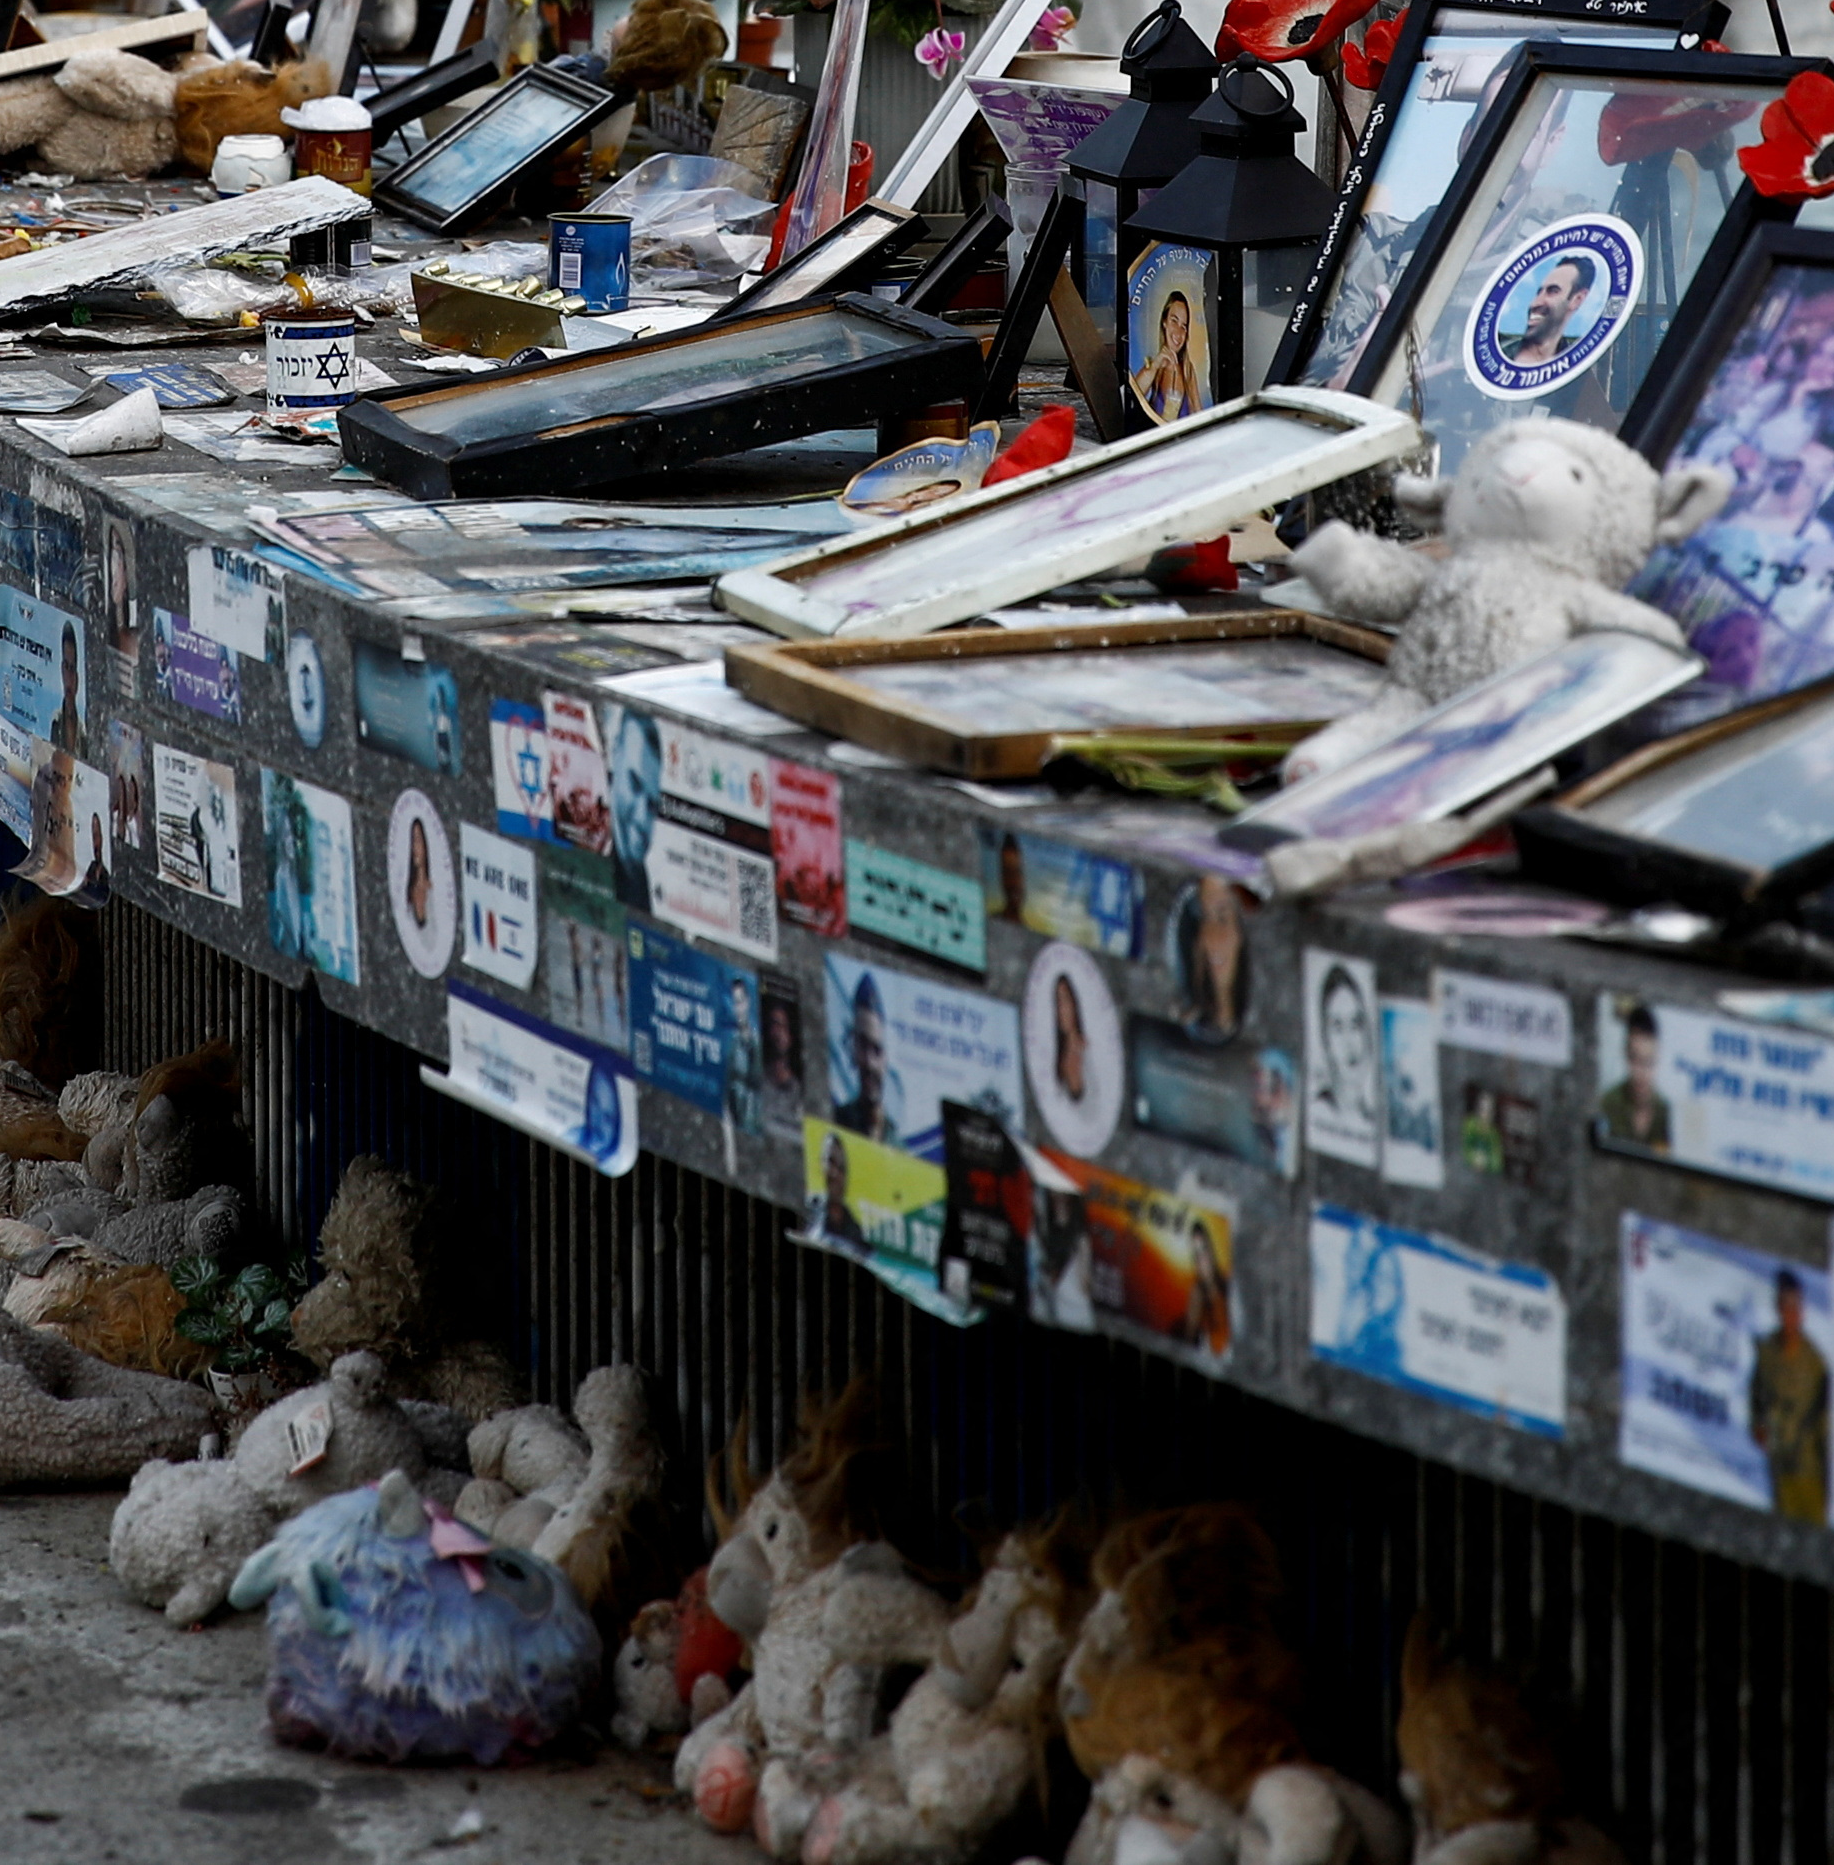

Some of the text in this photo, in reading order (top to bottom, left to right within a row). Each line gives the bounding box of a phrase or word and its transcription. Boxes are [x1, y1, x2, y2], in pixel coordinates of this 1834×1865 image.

[1306, 275, 1318, 293] no
[1317, 201, 1348, 270] mountain
[1342, 165, 1363, 195] high
[1359, 102, 1387, 158] enough
[1553, 228, 1588, 249] לחיות
[1589, 231, 1605, 244] יש
[1155, 254, 1167, 268] על
[1169, 246, 1193, 262] ולעוף
[1195, 251, 1209, 269] כל
[1603, 238, 1626, 265] החיים
[276, 356, 314, 377] יזכור
[1495, 363, 1516, 386] טל
[1520, 356, 1570, 387] איתמר
[466, 855, 529, 901] WE ARE ONE
